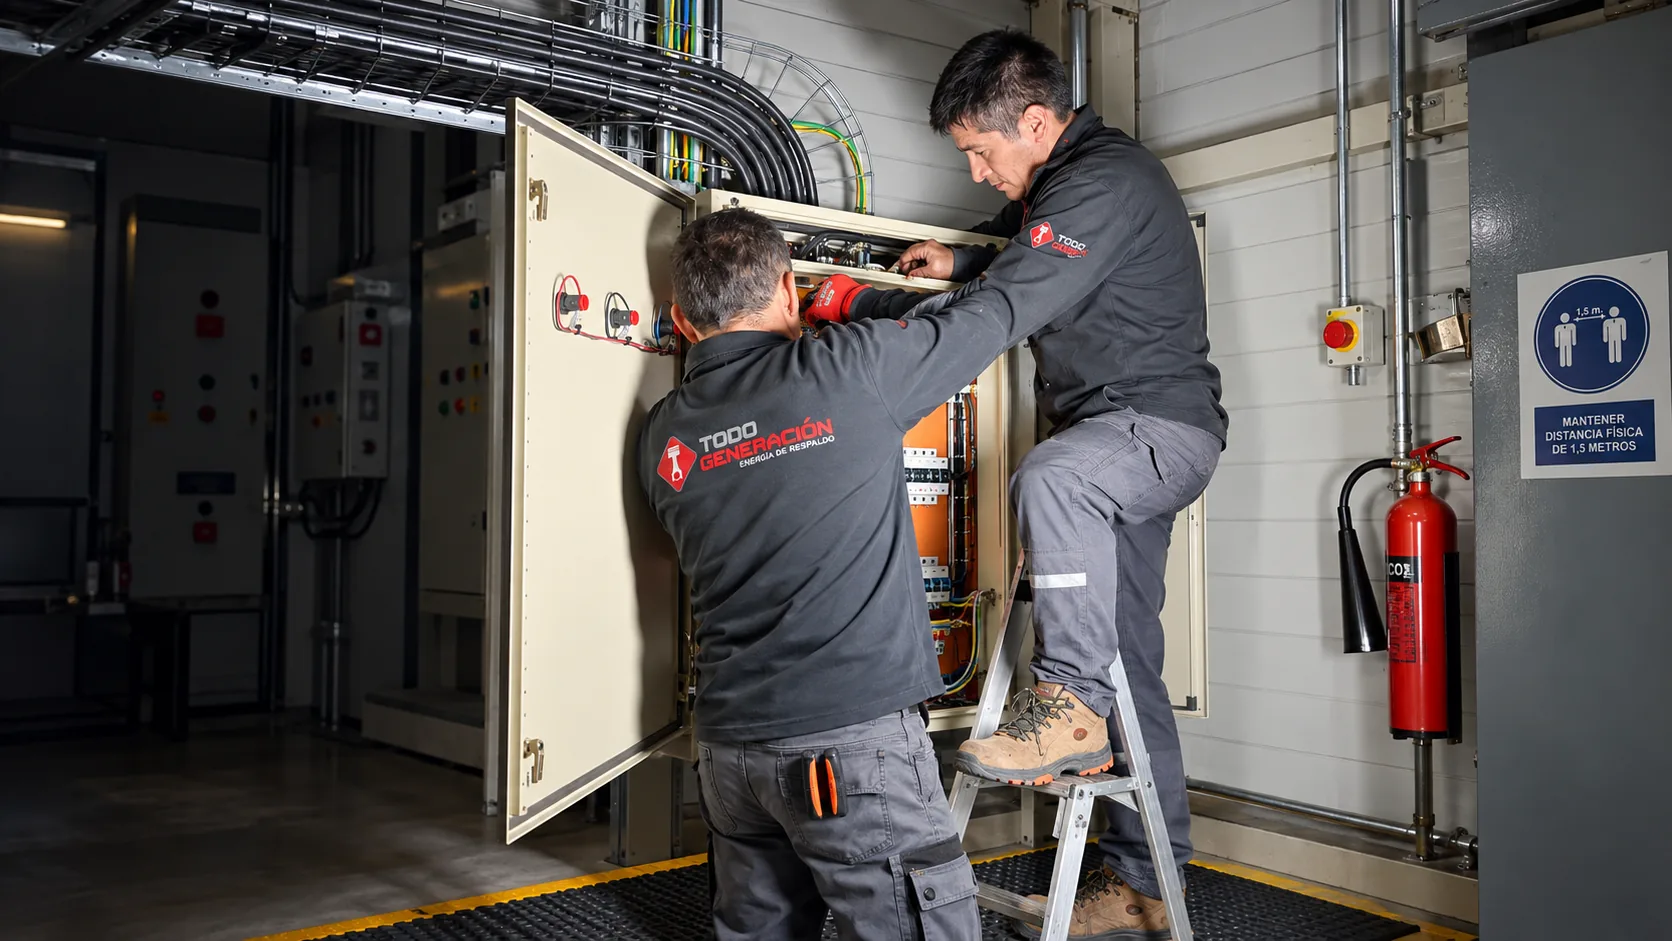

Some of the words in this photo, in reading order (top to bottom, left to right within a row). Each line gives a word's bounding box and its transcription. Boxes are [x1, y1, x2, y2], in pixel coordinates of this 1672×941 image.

[1058, 234, 1086, 251] TODO
[1576, 307, 1589, 316] 1,5
[1591, 306, 1603, 315] m.
[1562, 413, 1625, 427] MANTENER
[699, 421, 758, 452] TODO
[1545, 429, 1603, 442] DISTANCIA
[1606, 426, 1644, 438] FÍSICA
[700, 416, 834, 471] GENERACIÓN
[775, 447, 788, 457] DE
[789, 435, 835, 453] RESPALDO
[1552, 444, 1567, 454] DE
[1570, 443, 1586, 454] 1,5
[1588, 441, 1637, 453] METROS
